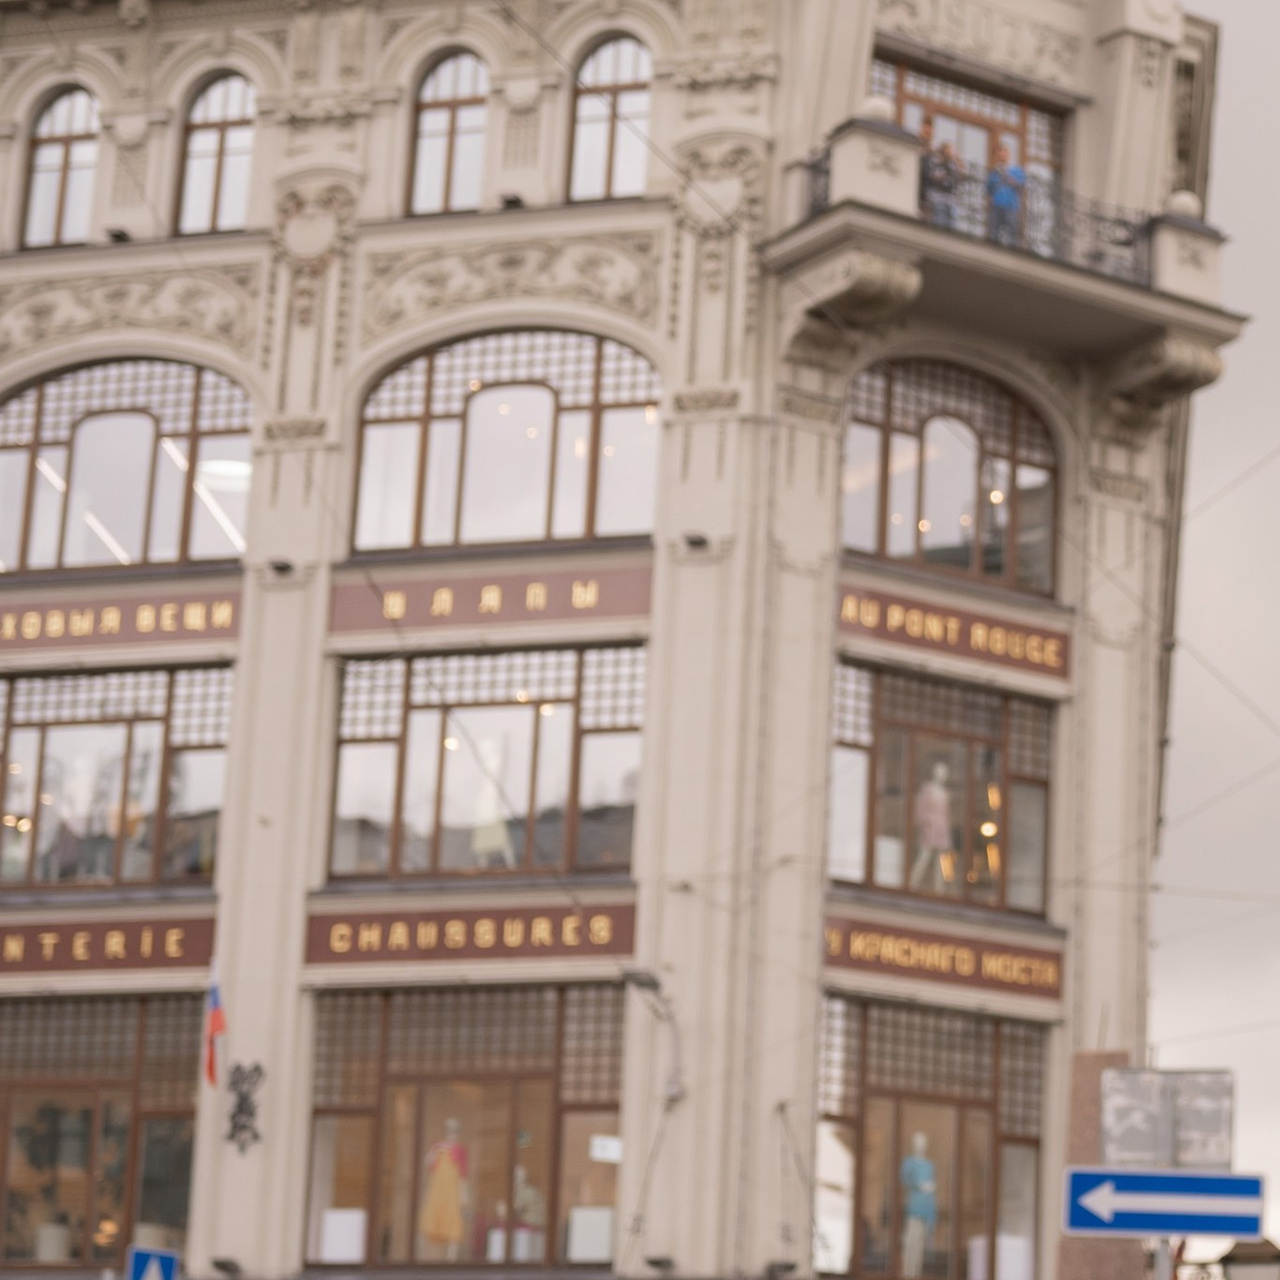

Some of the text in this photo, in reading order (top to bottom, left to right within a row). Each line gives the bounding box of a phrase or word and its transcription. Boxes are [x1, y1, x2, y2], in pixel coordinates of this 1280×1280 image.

[135, 600, 234, 634] ВЕЩИ
[383, 578, 600, 621] ШЛЯПЫ
[841, 594, 1064, 669] AU PONT ROUGE
[329, 913, 614, 955] CHAUSSURES
[850, 930, 977, 978] КРАСНАГО
[981, 950, 1060, 990] МОСТА
